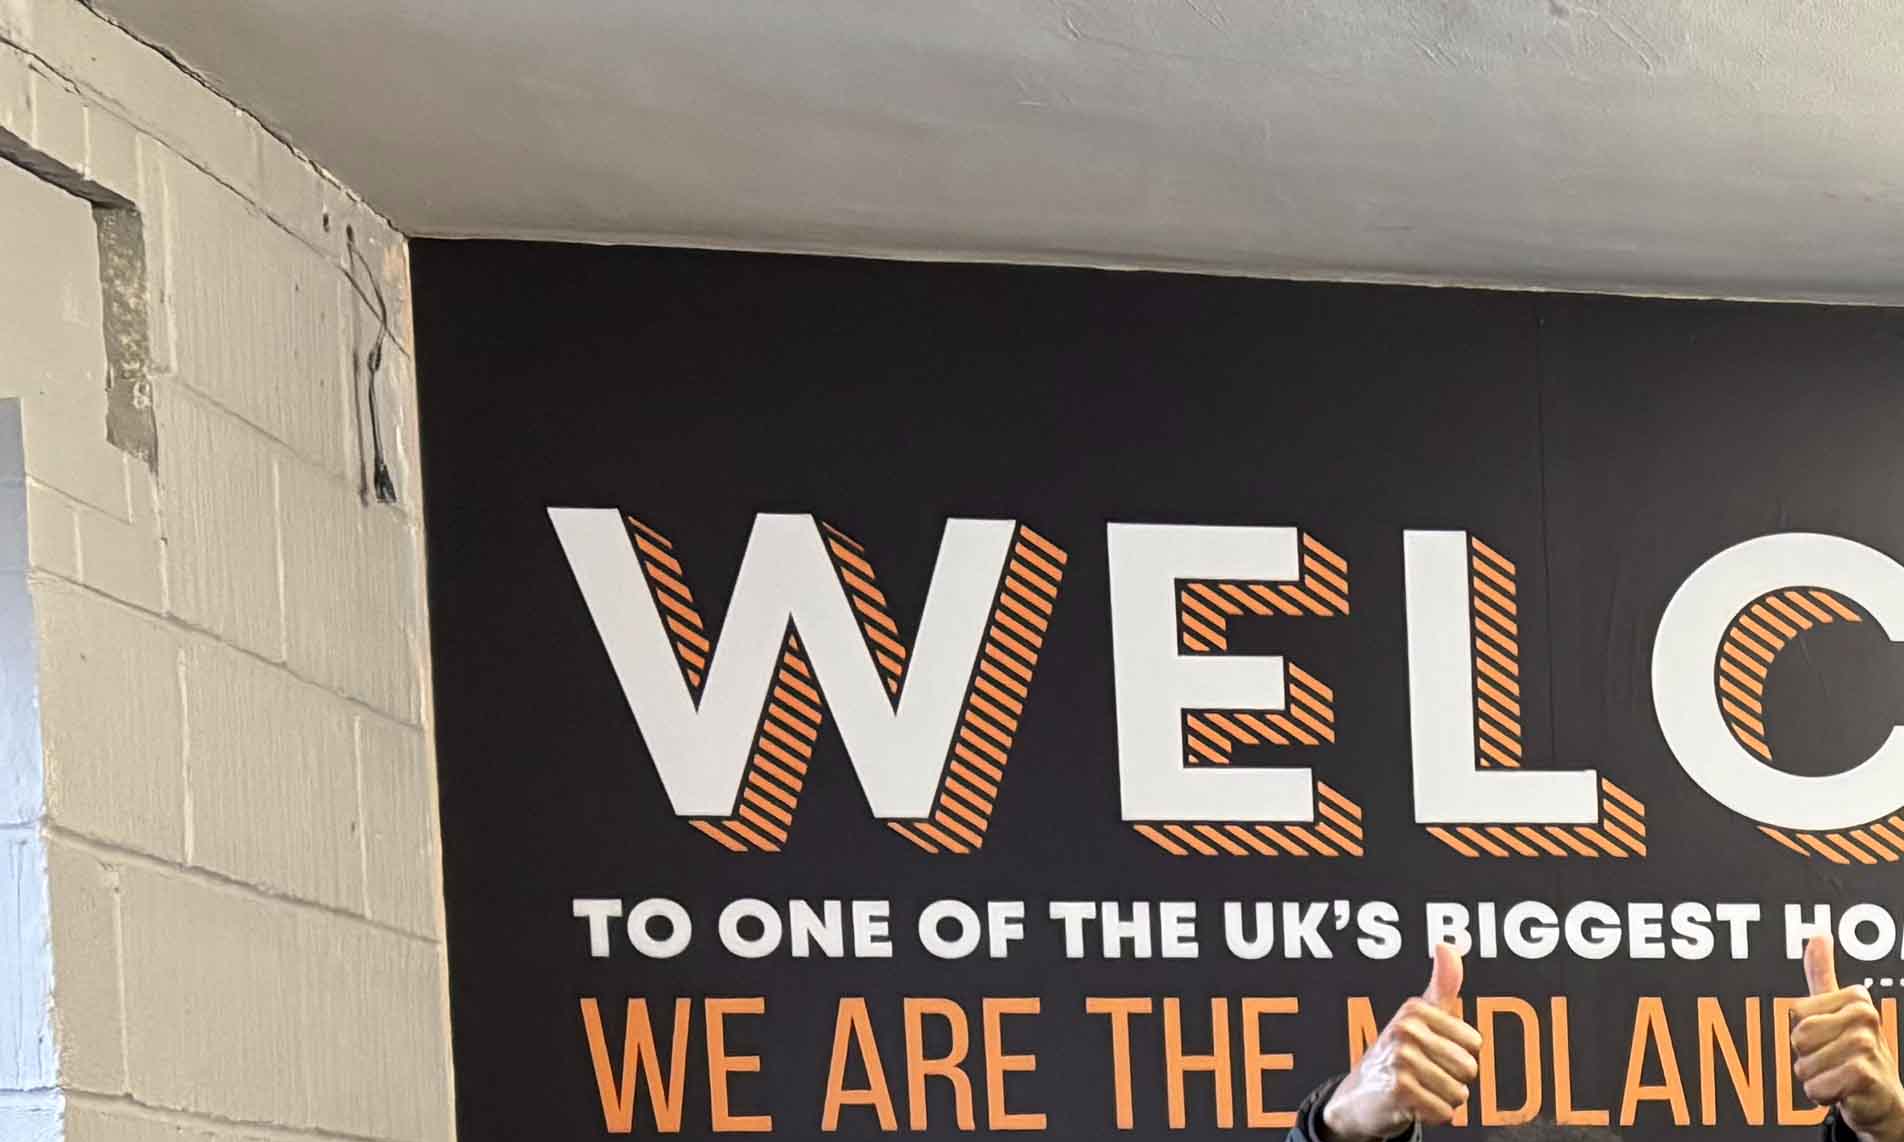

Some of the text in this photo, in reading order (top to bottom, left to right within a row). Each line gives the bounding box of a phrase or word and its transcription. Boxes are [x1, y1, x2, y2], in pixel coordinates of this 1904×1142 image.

[573, 898, 692, 958] TO
[719, 899, 892, 958] ONE
[919, 900, 1024, 959] OF
[1049, 902, 1199, 958] THE
[1224, 900, 1402, 960] UK'S
[1430, 901, 1760, 961] BIGGEST
[581, 998, 772, 1132] WE
[822, 998, 1046, 1131] ARE
[1086, 997, 1298, 1129] THE
